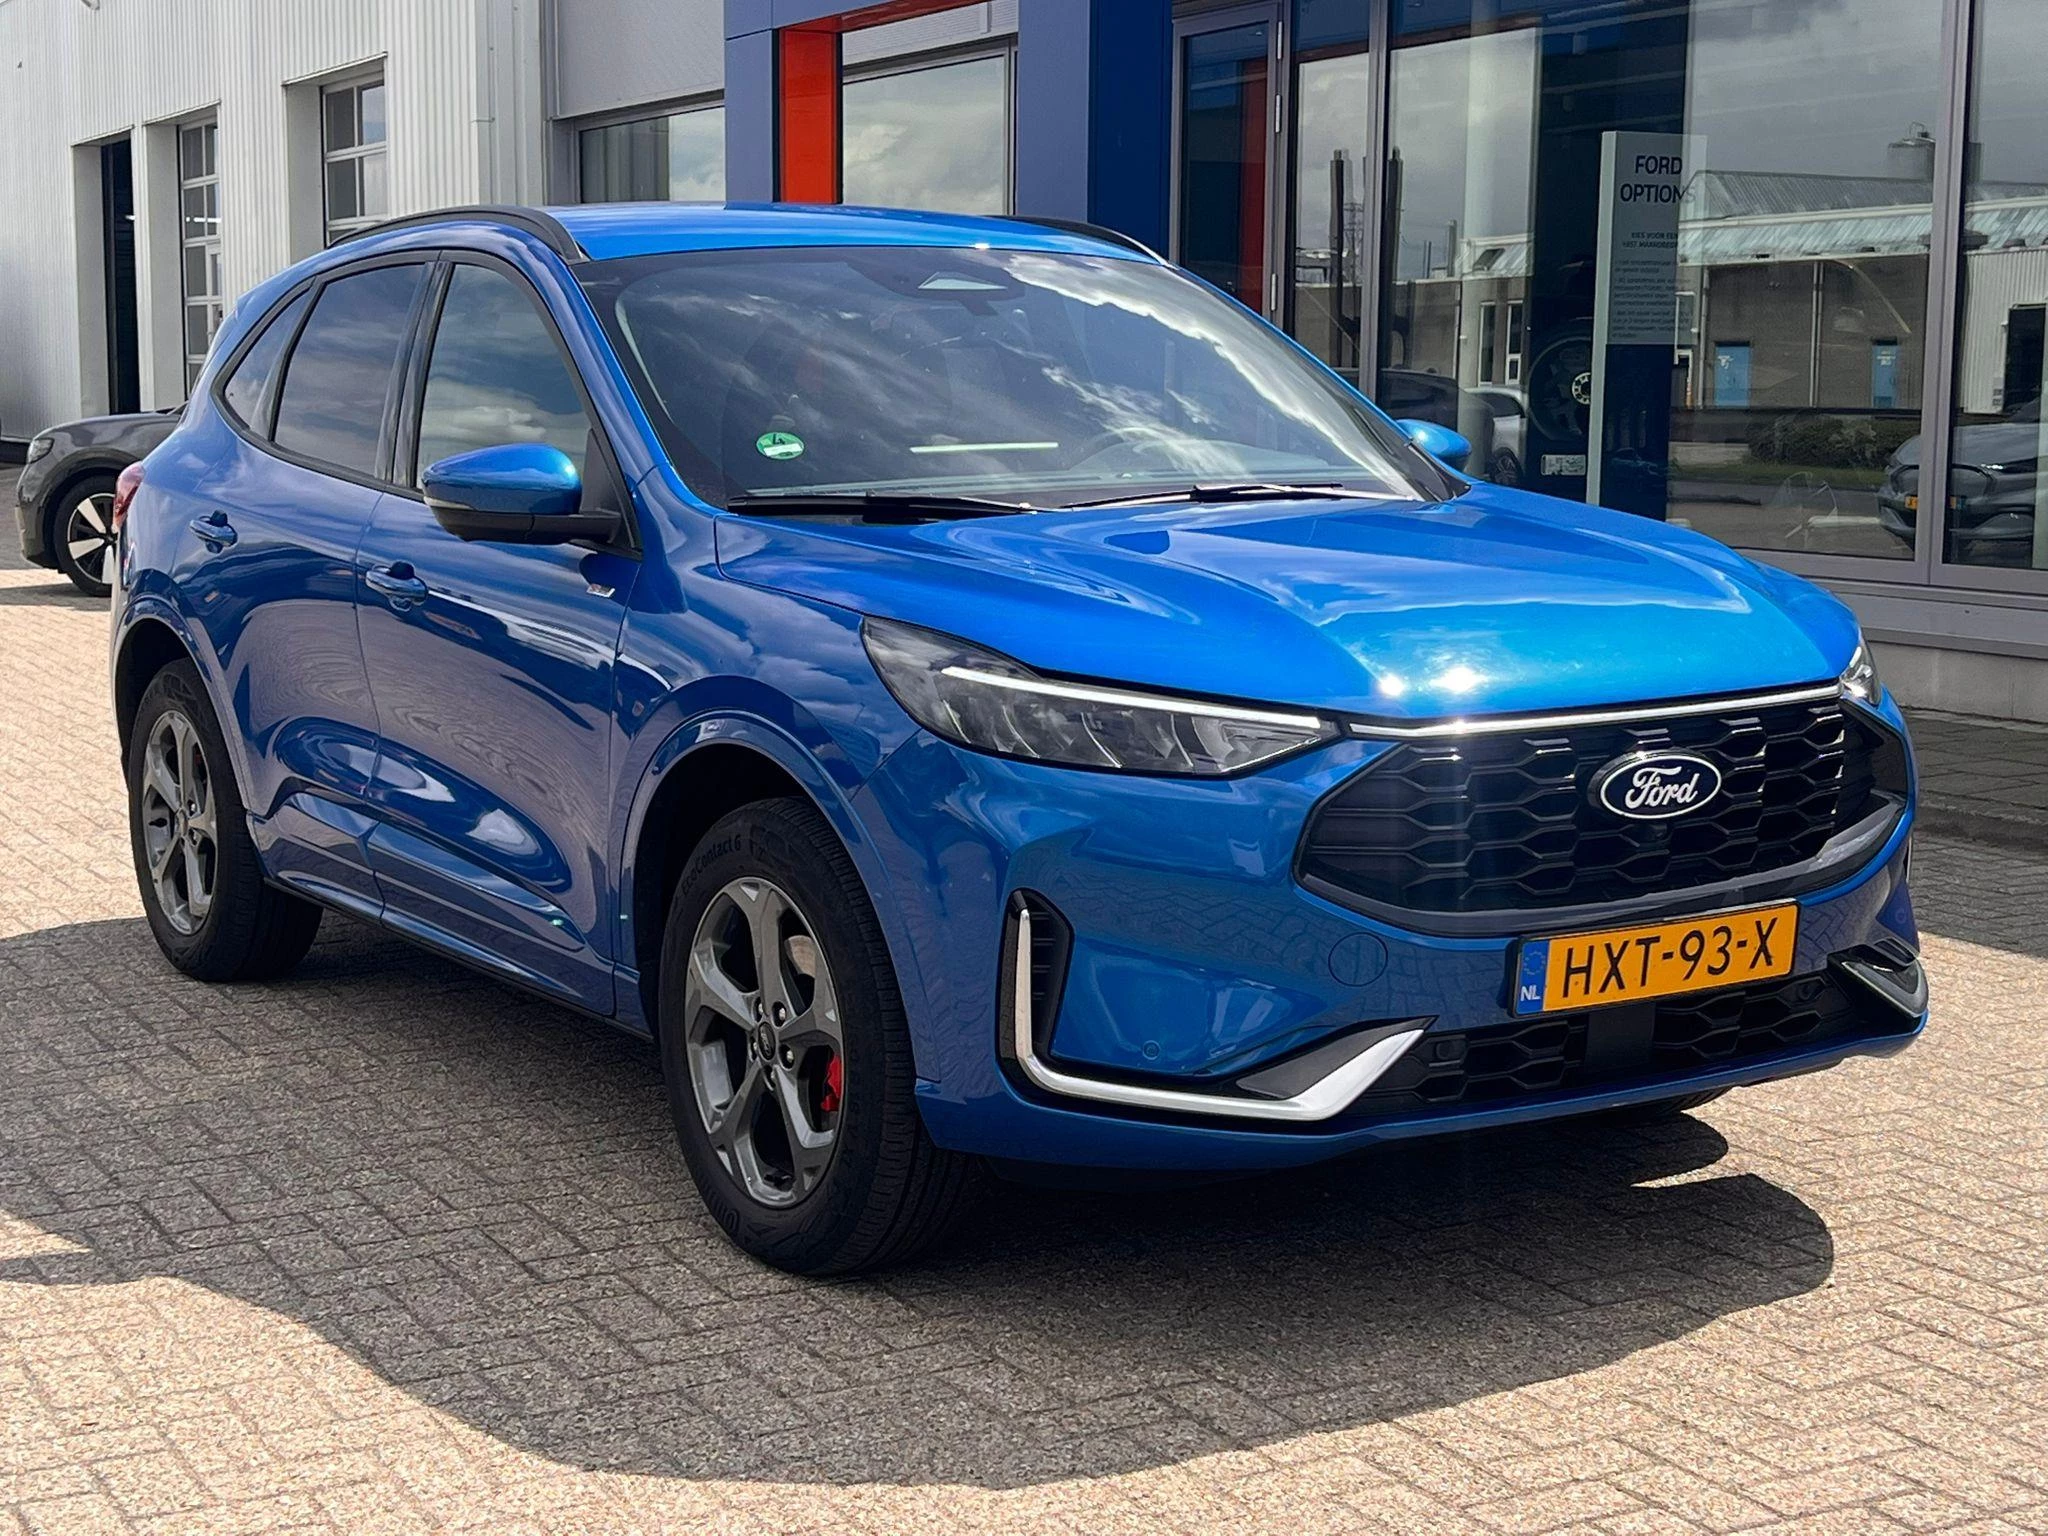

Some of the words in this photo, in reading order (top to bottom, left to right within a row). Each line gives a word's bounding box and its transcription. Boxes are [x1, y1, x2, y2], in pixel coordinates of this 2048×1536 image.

[1635, 155, 1682, 174] FORD
[1620, 183, 1696, 204] OPTIONS
[1625, 766, 1700, 809] Ford
[1562, 917, 1778, 998] HXT-93-X
[1520, 985, 1541, 1002] NL
